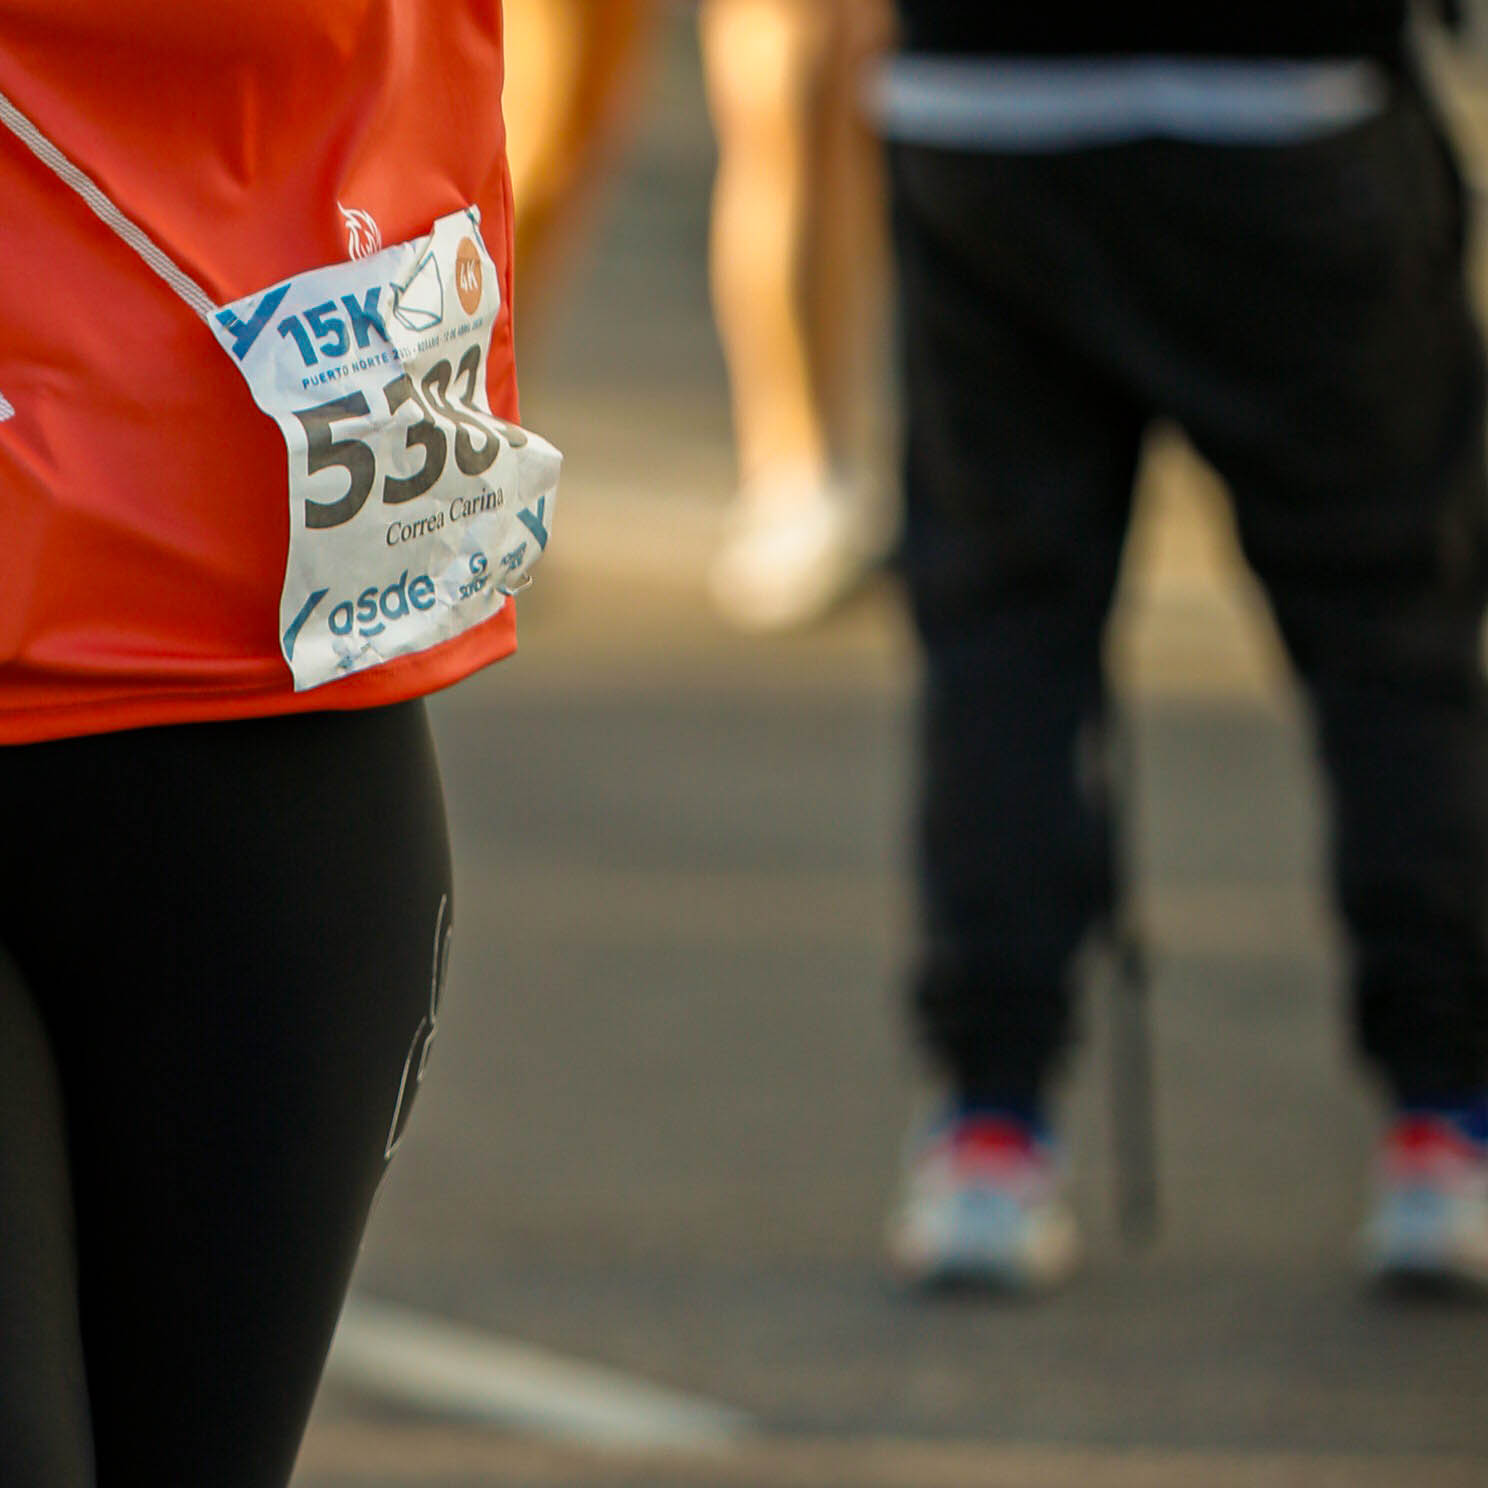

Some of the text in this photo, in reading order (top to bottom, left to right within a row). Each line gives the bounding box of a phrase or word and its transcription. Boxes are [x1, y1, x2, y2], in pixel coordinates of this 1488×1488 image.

[277, 286, 391, 367] 15K
[302, 365, 350, 389] PUERTO
[352, 351, 389, 373] NORTE
[386, 486, 504, 547] Correa Carina
